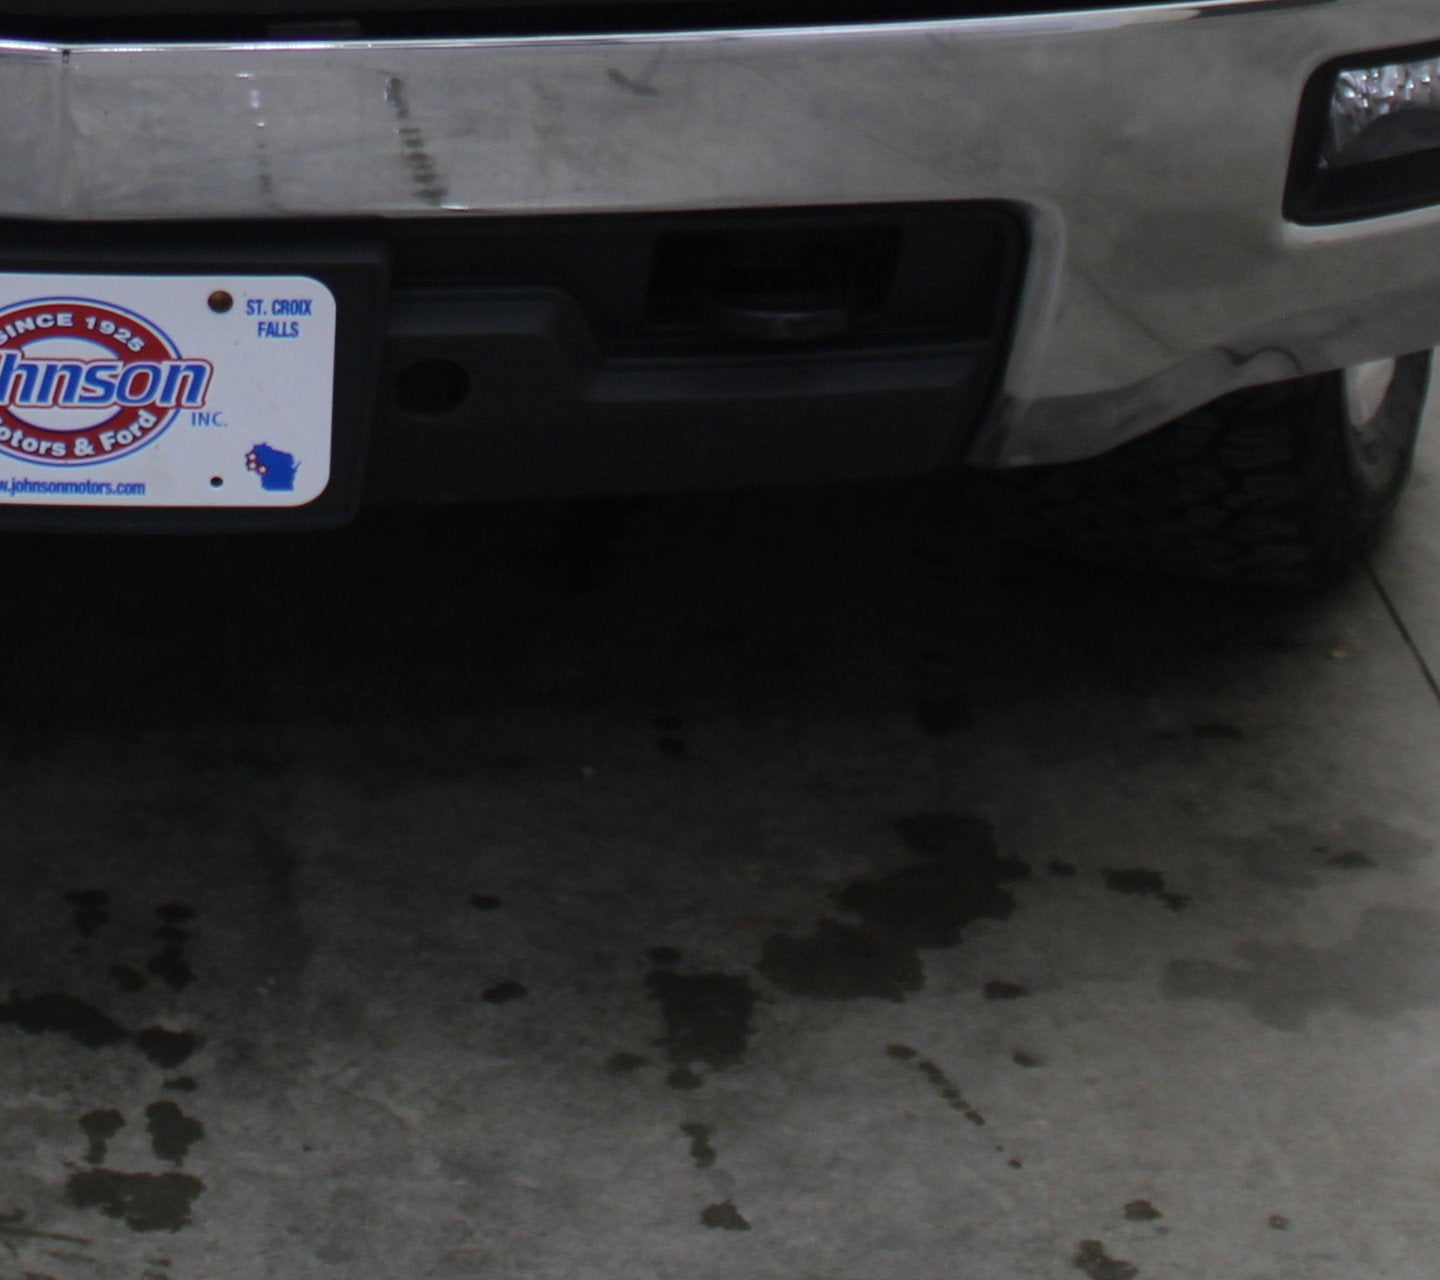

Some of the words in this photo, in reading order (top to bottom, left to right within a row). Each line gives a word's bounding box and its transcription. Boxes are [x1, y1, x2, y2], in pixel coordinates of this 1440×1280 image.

[245, 299, 267, 316] ST.
[271, 299, 313, 316] CROIX
[84, 316, 145, 353] 1925
[257, 321, 300, 339] FALLS
[190, 411, 228, 428] INC.
[73, 437, 95, 457] &
[98, 408, 158, 452] Ford
